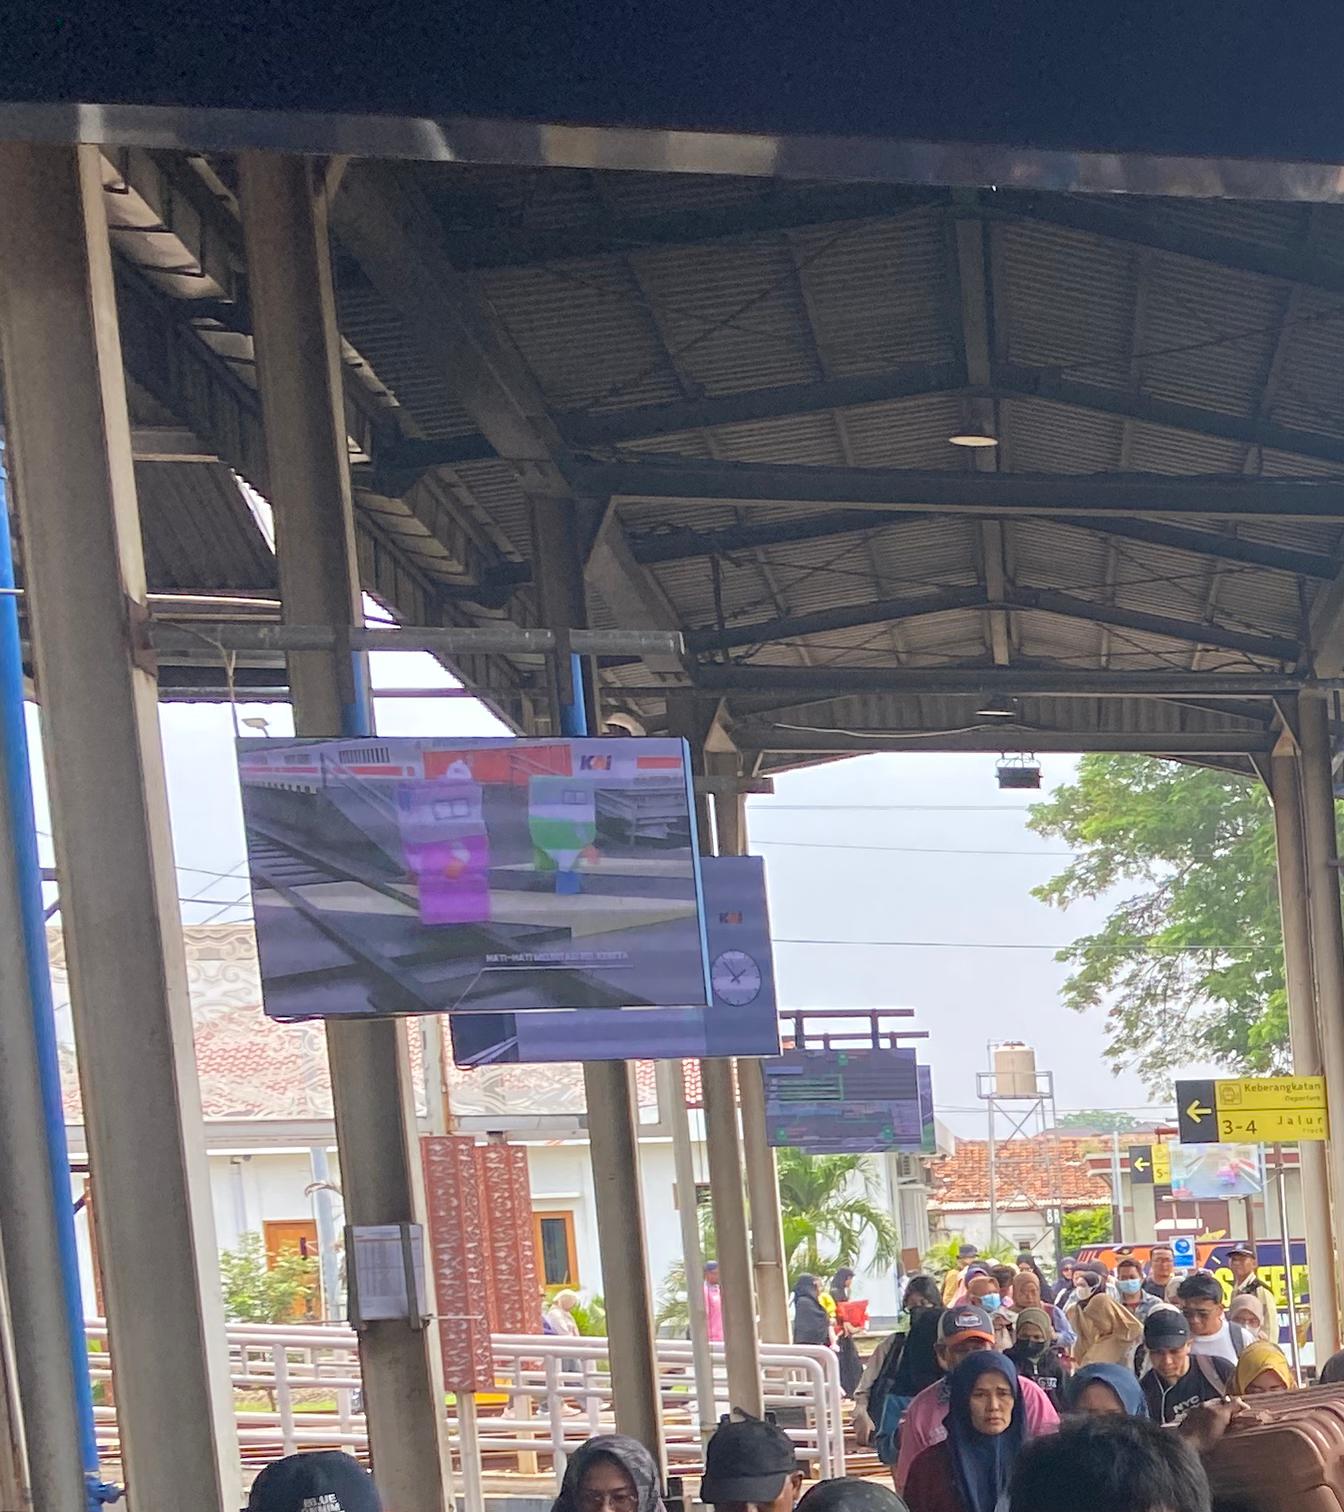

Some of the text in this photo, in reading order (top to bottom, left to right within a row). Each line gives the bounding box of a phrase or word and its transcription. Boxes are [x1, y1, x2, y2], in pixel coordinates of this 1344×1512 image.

[1244, 1082, 1321, 1094] Keberangkatan
[1222, 1119, 1258, 1135] 3-4
[1277, 1115, 1323, 1126] Jalur
[1172, 1395, 1200, 1414] NYC
